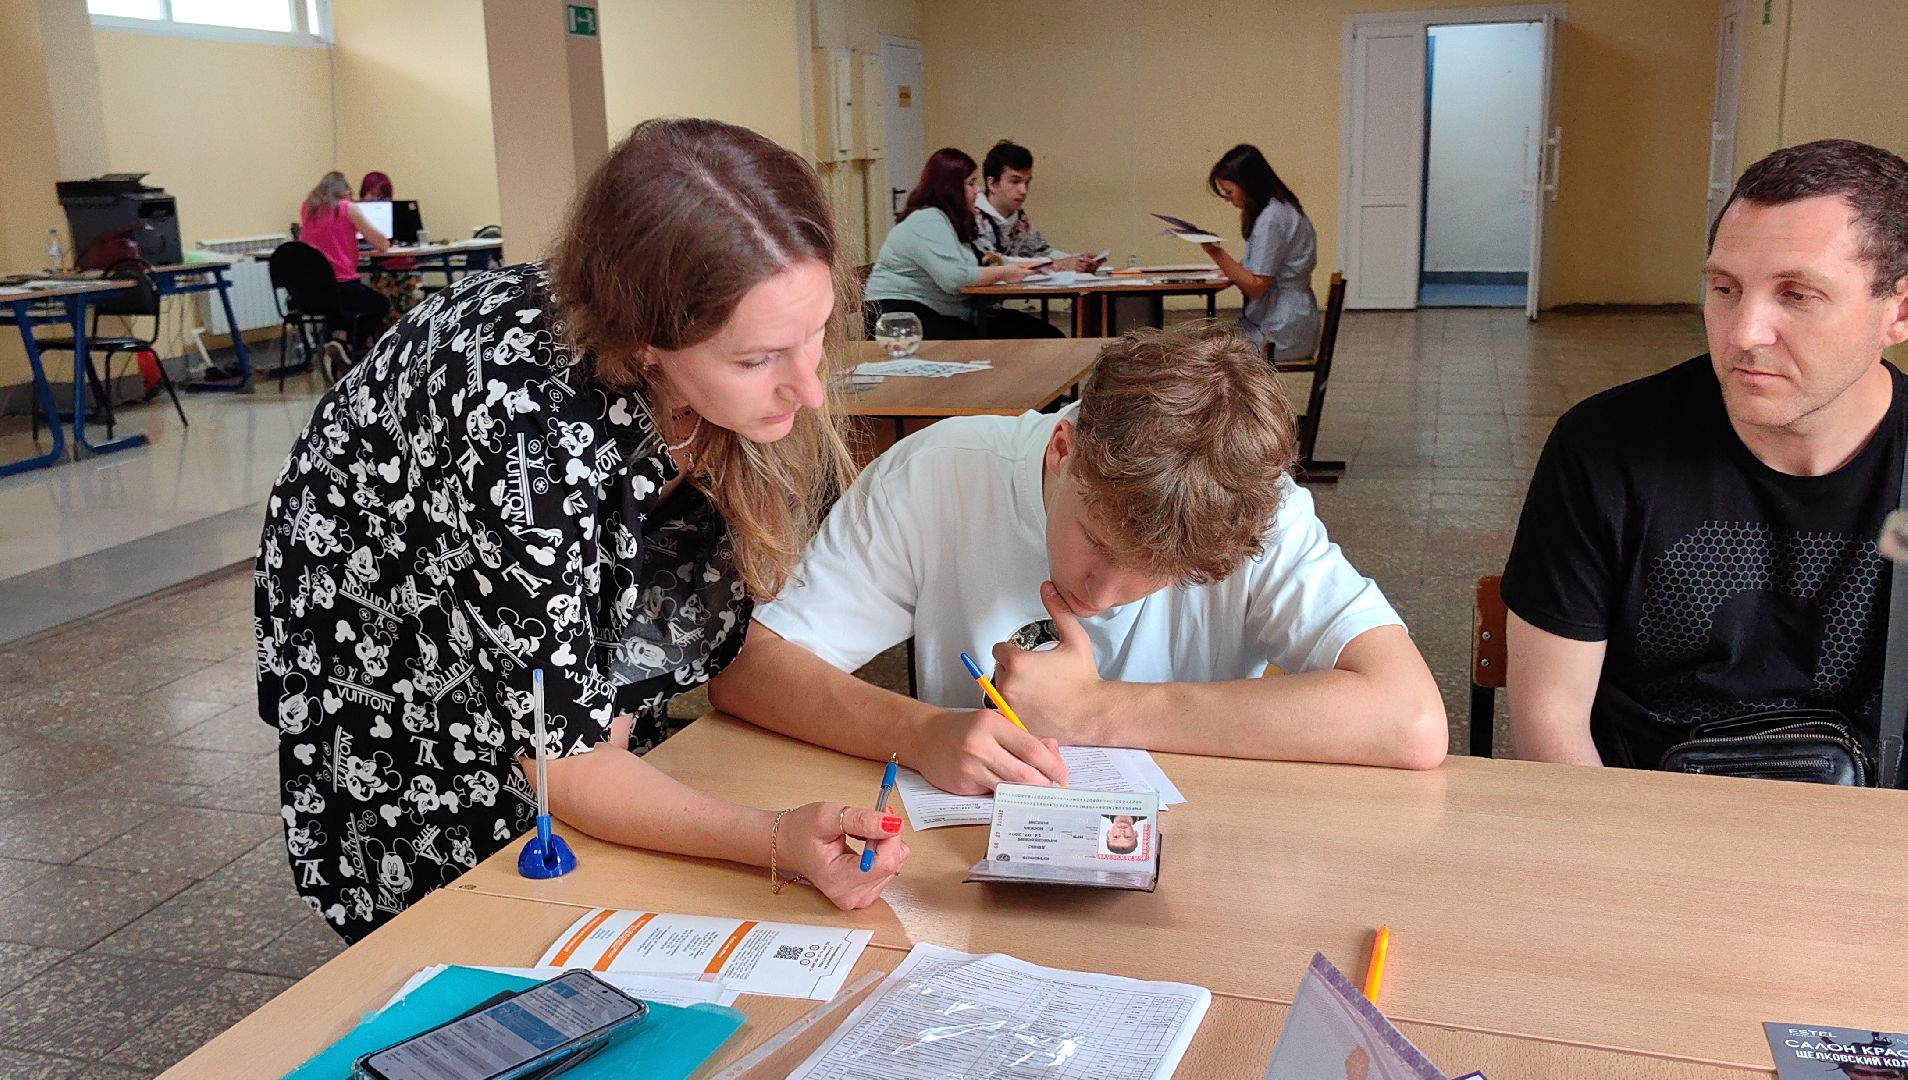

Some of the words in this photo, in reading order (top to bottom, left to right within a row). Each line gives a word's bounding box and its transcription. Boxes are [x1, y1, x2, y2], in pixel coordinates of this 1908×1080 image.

[466, 332, 478, 397] VUITTON
[506, 446, 526, 524] VUITTON
[341, 569, 396, 615] VUITTON
[336, 685, 392, 714] VUITTON
[337, 731, 354, 788] VUITTON
[1784, 1039, 1856, 1054] САЛОН
[1788, 1028, 1838, 1038] ESTEL
[1796, 1050, 1881, 1065] ЩЕЛКОВСКИЙ
